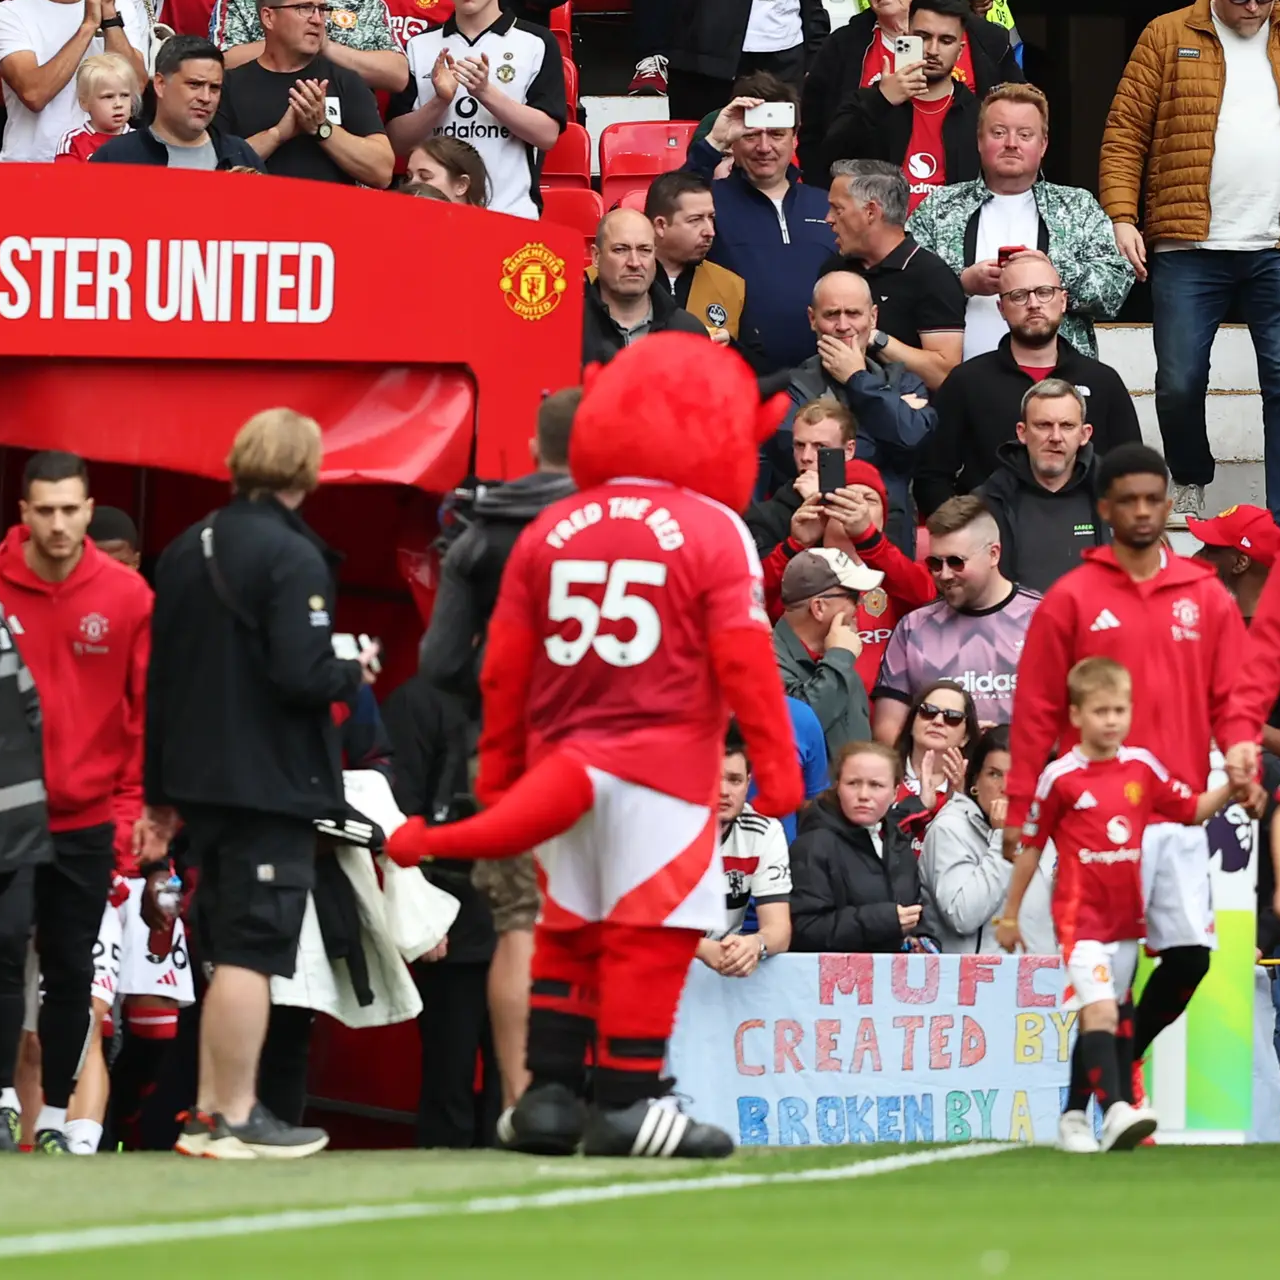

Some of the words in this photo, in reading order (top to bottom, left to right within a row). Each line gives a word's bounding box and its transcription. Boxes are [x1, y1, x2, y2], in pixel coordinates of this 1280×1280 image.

[145, 239, 334, 324] UNITED
[506, 246, 561, 275] MANCHESTER
[513, 300, 552, 318] UNITED
[545, 500, 603, 549] FRED
[608, 495, 654, 524] THE
[644, 508, 685, 552] RED
[544, 559, 667, 667] 55
[817, 952, 1061, 1008] MUFC
[733, 1015, 987, 1077] CREATED
[1014, 1010, 1078, 1064] BY
[736, 1091, 934, 1146] BROKEN
[945, 1088, 1000, 1143] BY
[1008, 1090, 1035, 1145] A
